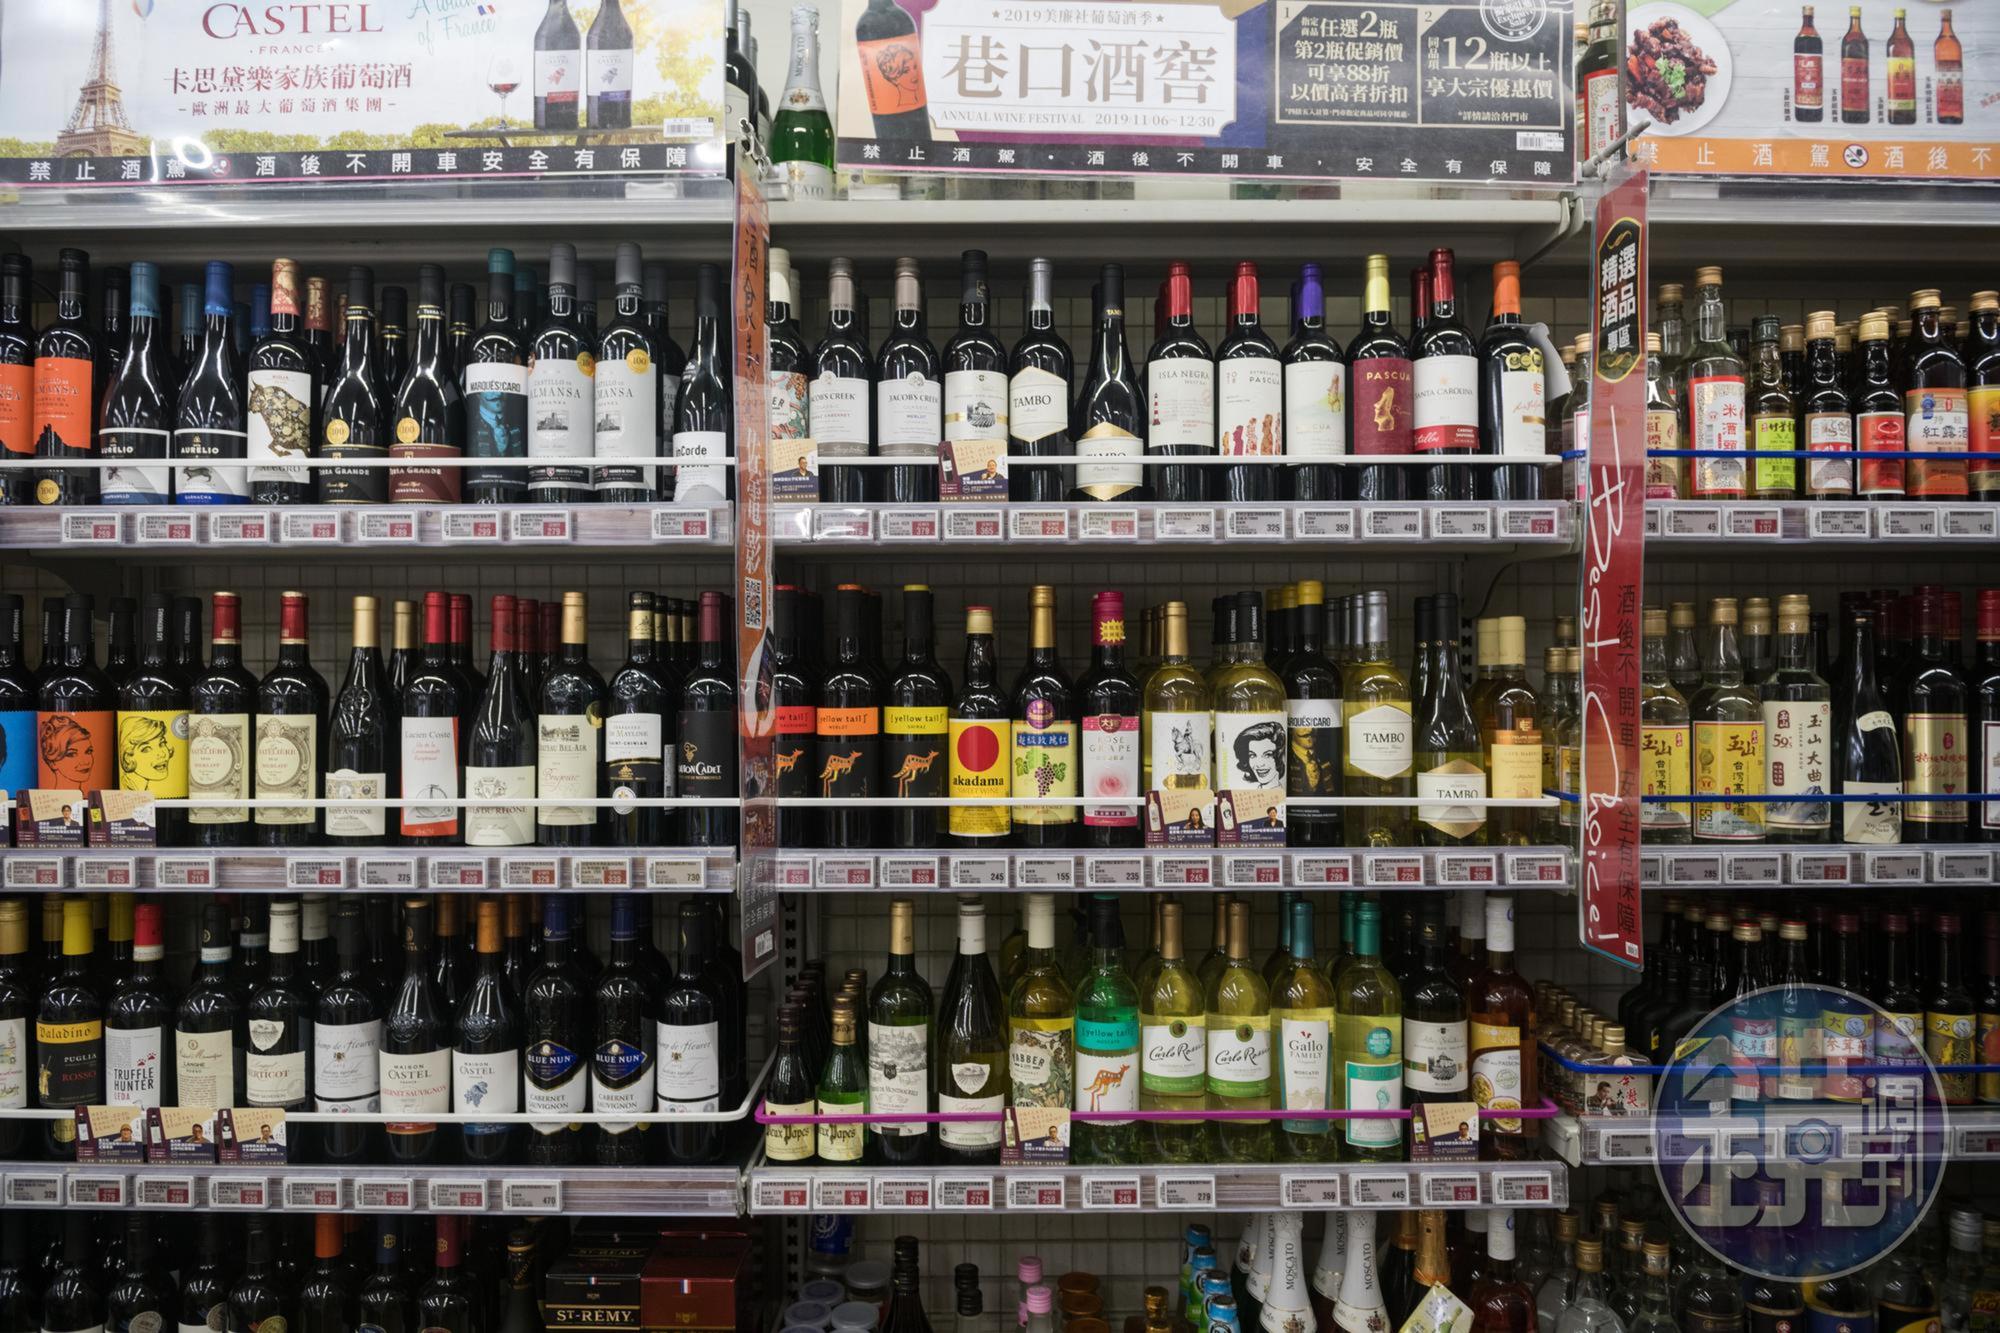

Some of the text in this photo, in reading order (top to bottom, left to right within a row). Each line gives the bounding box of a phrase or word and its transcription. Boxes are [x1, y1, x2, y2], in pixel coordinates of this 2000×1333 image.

[201, 3, 384, 39] CASTEL
[1003, 8, 1154, 28] 2019美廉社葡萄酒季
[1424, 10, 1433, 23] 2
[1320, 10, 1399, 40] 任選2瓶
[1294, 39, 1404, 62] 第2瓶促銷價
[1441, 36, 1553, 73] 12瓶以上
[941, 33, 1218, 105] 巷口酒窖
[1306, 62, 1391, 84] 可享88折
[163, 61, 413, 95] 卡思黛樂家族葡萄酒
[1290, 82, 1408, 104] 以價高者折扣
[1424, 76, 1554, 100] 享大宗優惠價
[940, 110, 1085, 126] ANNUAL WINE FESTIVAL
[862, 143, 1016, 164] 禁止酒駕
[1636, 141, 1992, 172] 禁止酒駕 酒後不
[29, 147, 688, 181] 禁止酒駕 酒後不開車安全有保障
[1602, 243, 1636, 291] 精選
[1602, 282, 1636, 328] 酒品
[1607, 324, 1631, 353] 專區
[1159, 369, 1210, 380] ISLA NEGRA
[1366, 371, 1412, 382] PASCUA
[1249, 376, 1281, 386] PASCUA
[501, 382, 521, 392] CARO
[530, 387, 582, 399] ALMANSA
[829, 392, 856, 401] CREEK
[1013, 394, 1052, 408] TAMBO
[1921, 426, 1968, 438] 紅露酒
[181, 446, 220, 455] AURELIO
[334, 467, 370, 475] GRANDE
[407, 467, 442, 475] GRANDE
[40, 486, 55, 496] 100
[1266, 523, 1281, 532] 325
[1335, 523, 1350, 532] 359
[1403, 523, 1418, 532] 489
[1472, 523, 1487, 532] 375
[1707, 522, 1717, 531] 45
[1919, 523, 1932, 532] 147
[1979, 523, 1992, 532] 142
[1313, 717, 1331, 727] CARO
[1363, 732, 1405, 744] TAMBO
[1642, 733, 1672, 756] 玉山
[1725, 734, 1757, 757] 玉山
[1806, 714, 1823, 783] 玉山大曲
[1616, 584, 1636, 935] 酒後不開車 安全有保障
[952, 774, 1005, 787] akadama
[1435, 788, 1479, 798] TAMBO
[686, 872, 701, 882] 730
[990, 872, 1005, 882] 245
[1056, 872, 1070, 881] 155
[1125, 872, 1140, 881] 235
[1644, 870, 1657, 879] 147
[1703, 869, 1718, 878] 285
[1906, 867, 1919, 876] 147
[397, 873, 412, 883] 275
[1935, 1019, 1951, 1031] 大
[1288, 1039, 1324, 1053] Gallo
[63, 1053, 97, 1063] PUGLIA
[527, 1054, 571, 1064] BLUE NUN
[596, 1054, 640, 1063] BLUE NUN
[1149, 1046, 1175, 1062] Carlo
[1214, 1049, 1242, 1066] Carlo
[1289, 1051, 1323, 1060] FAMILY
[113, 1066, 154, 1080] TRUFFLE
[387, 1068, 432, 1080] CASTEL
[459, 1065, 496, 1075] CASTEL
[60, 1070, 97, 1082] ROSSO
[113, 1079, 155, 1092] HUNTER
[113, 1091, 130, 1100] LEDA
[530, 1093, 565, 1102] CABERNET
[598, 1093, 634, 1102] CABERNET
[528, 1102, 569, 1110] SAUVIGNON
[789, 1195, 800, 1204] 99
[1197, 1192, 1211, 1202] 279
[1391, 1190, 1405, 1199] 445
[1286, 1242, 1296, 1291] MOSCATO
[1363, 1242, 1374, 1291] MOSCATO
